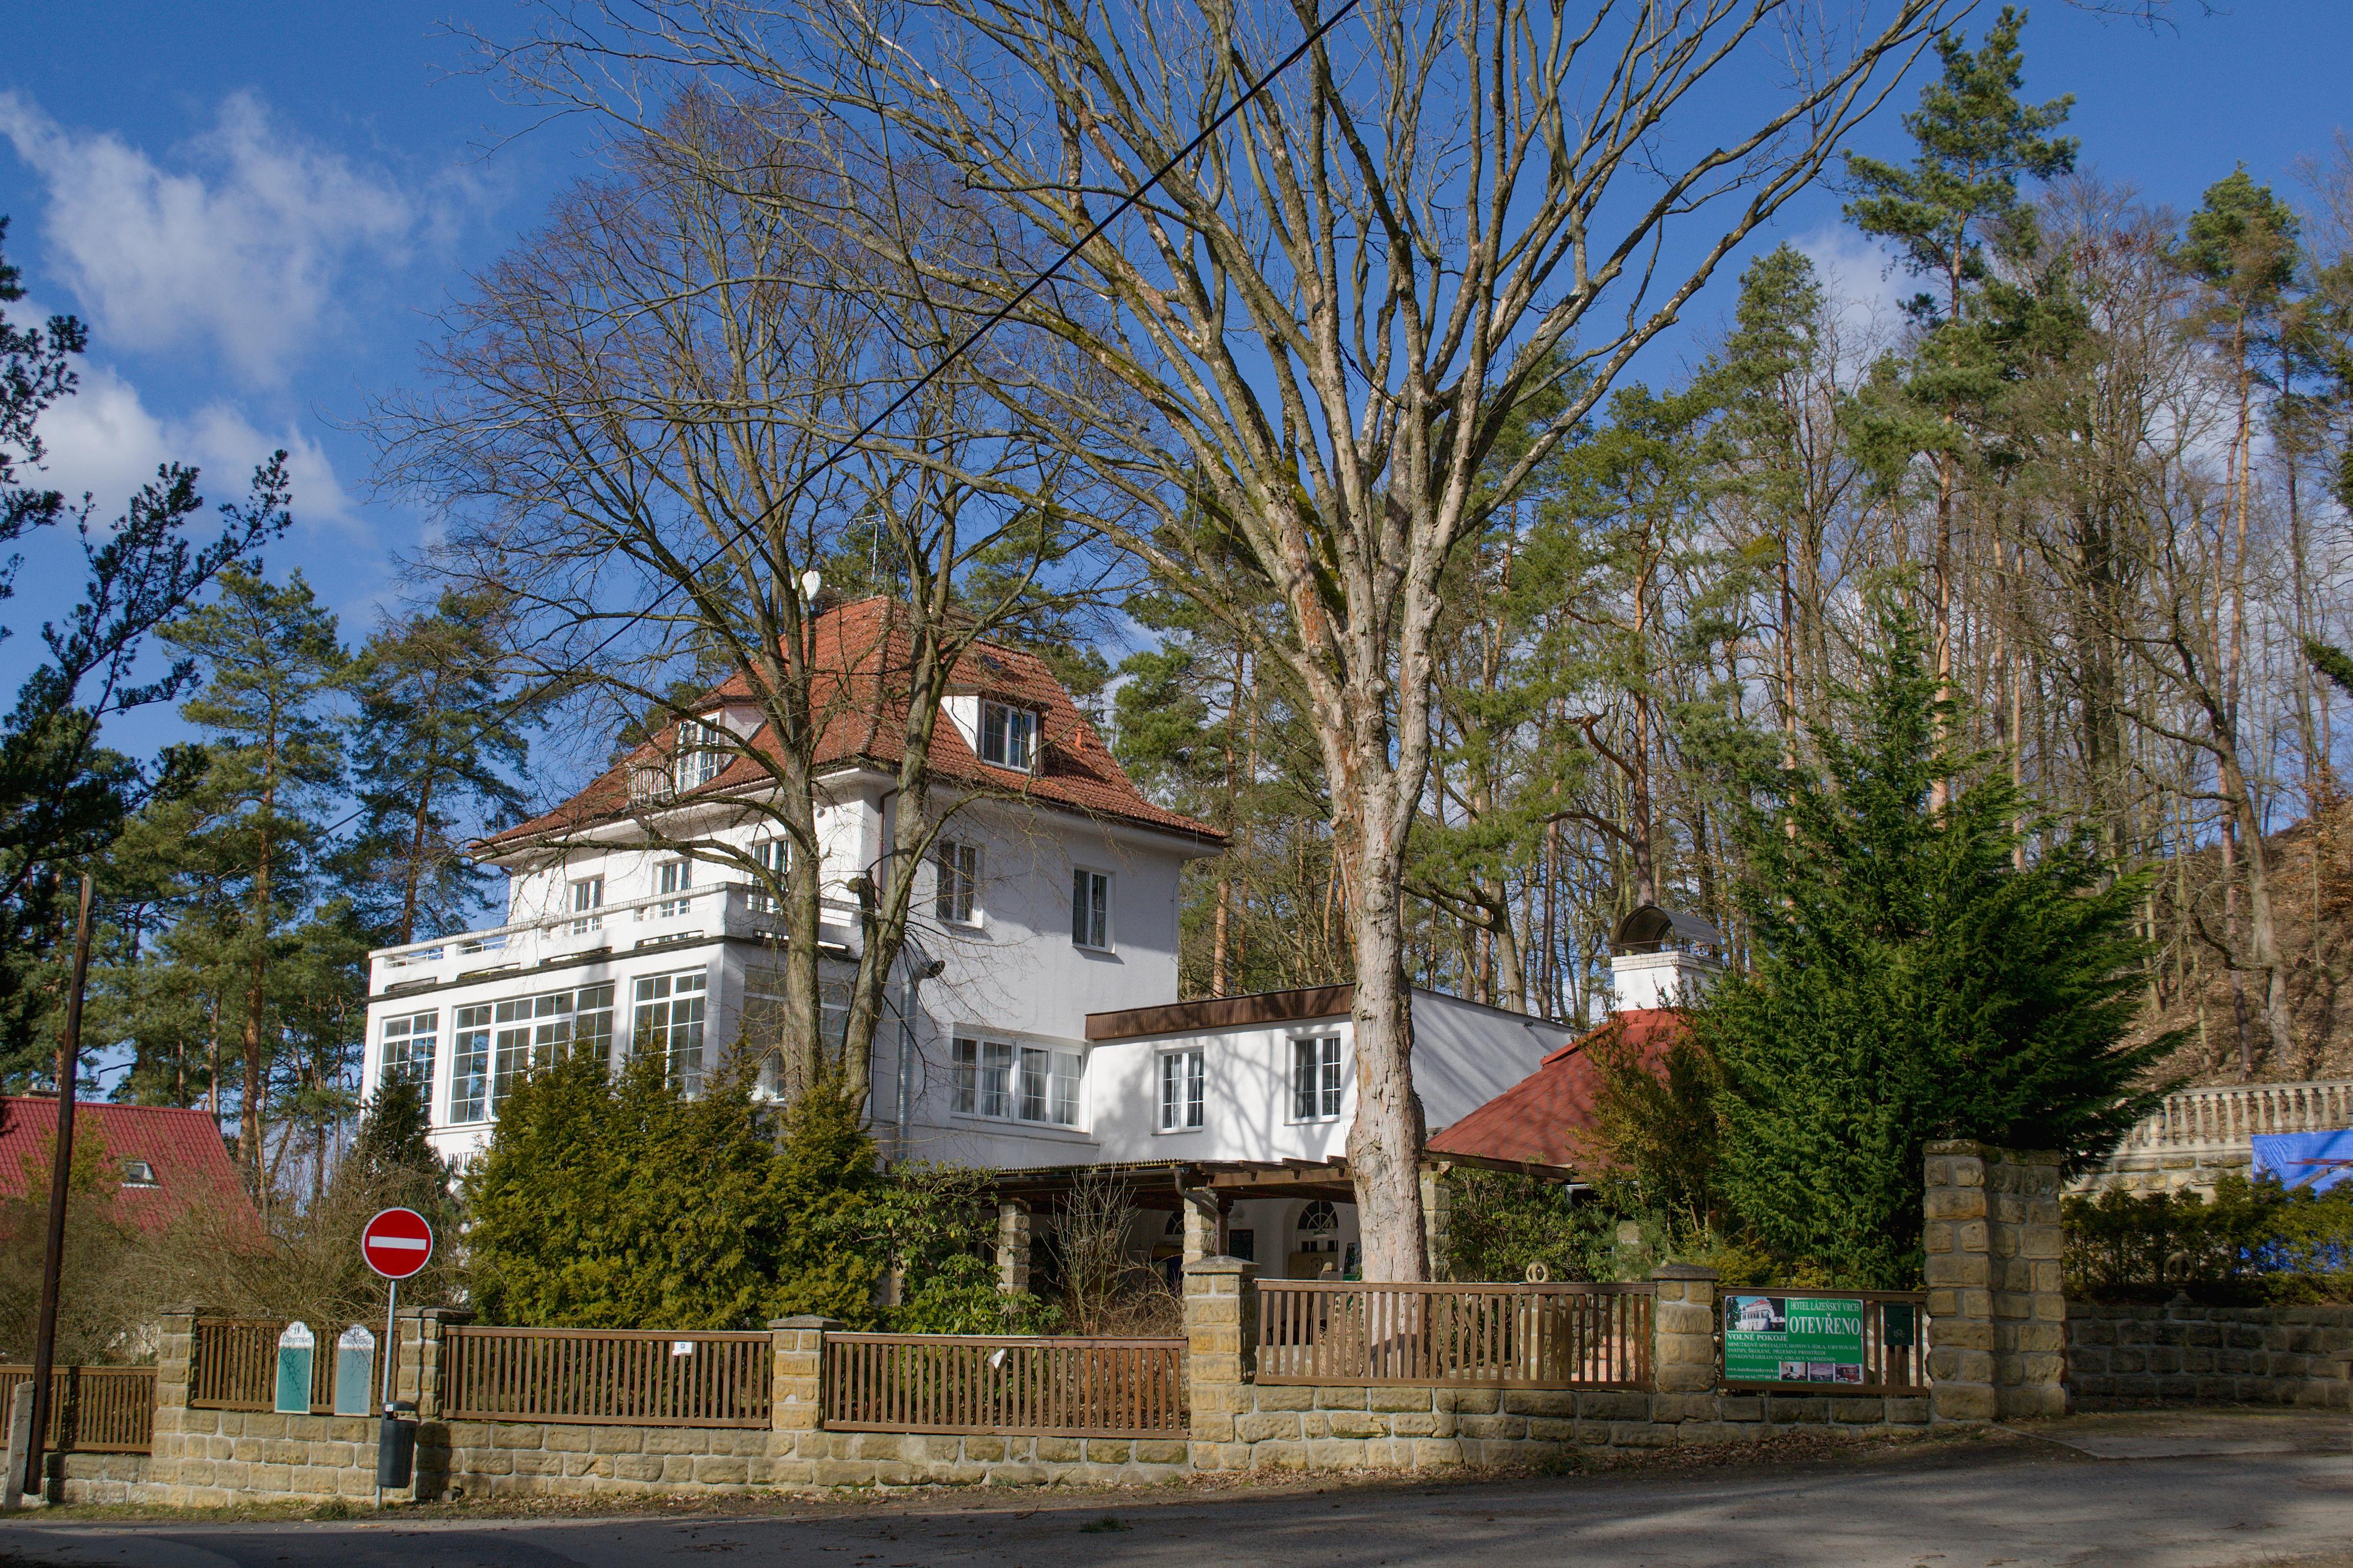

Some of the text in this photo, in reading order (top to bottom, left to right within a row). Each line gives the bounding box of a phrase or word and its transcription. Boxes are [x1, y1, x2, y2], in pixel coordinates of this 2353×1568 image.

[1791, 1302, 1810, 1310] HOTEL
[1811, 1300, 1841, 1312] LÁZEŇSKÝ
[1789, 1313, 1861, 1336] OTEVŘENO
